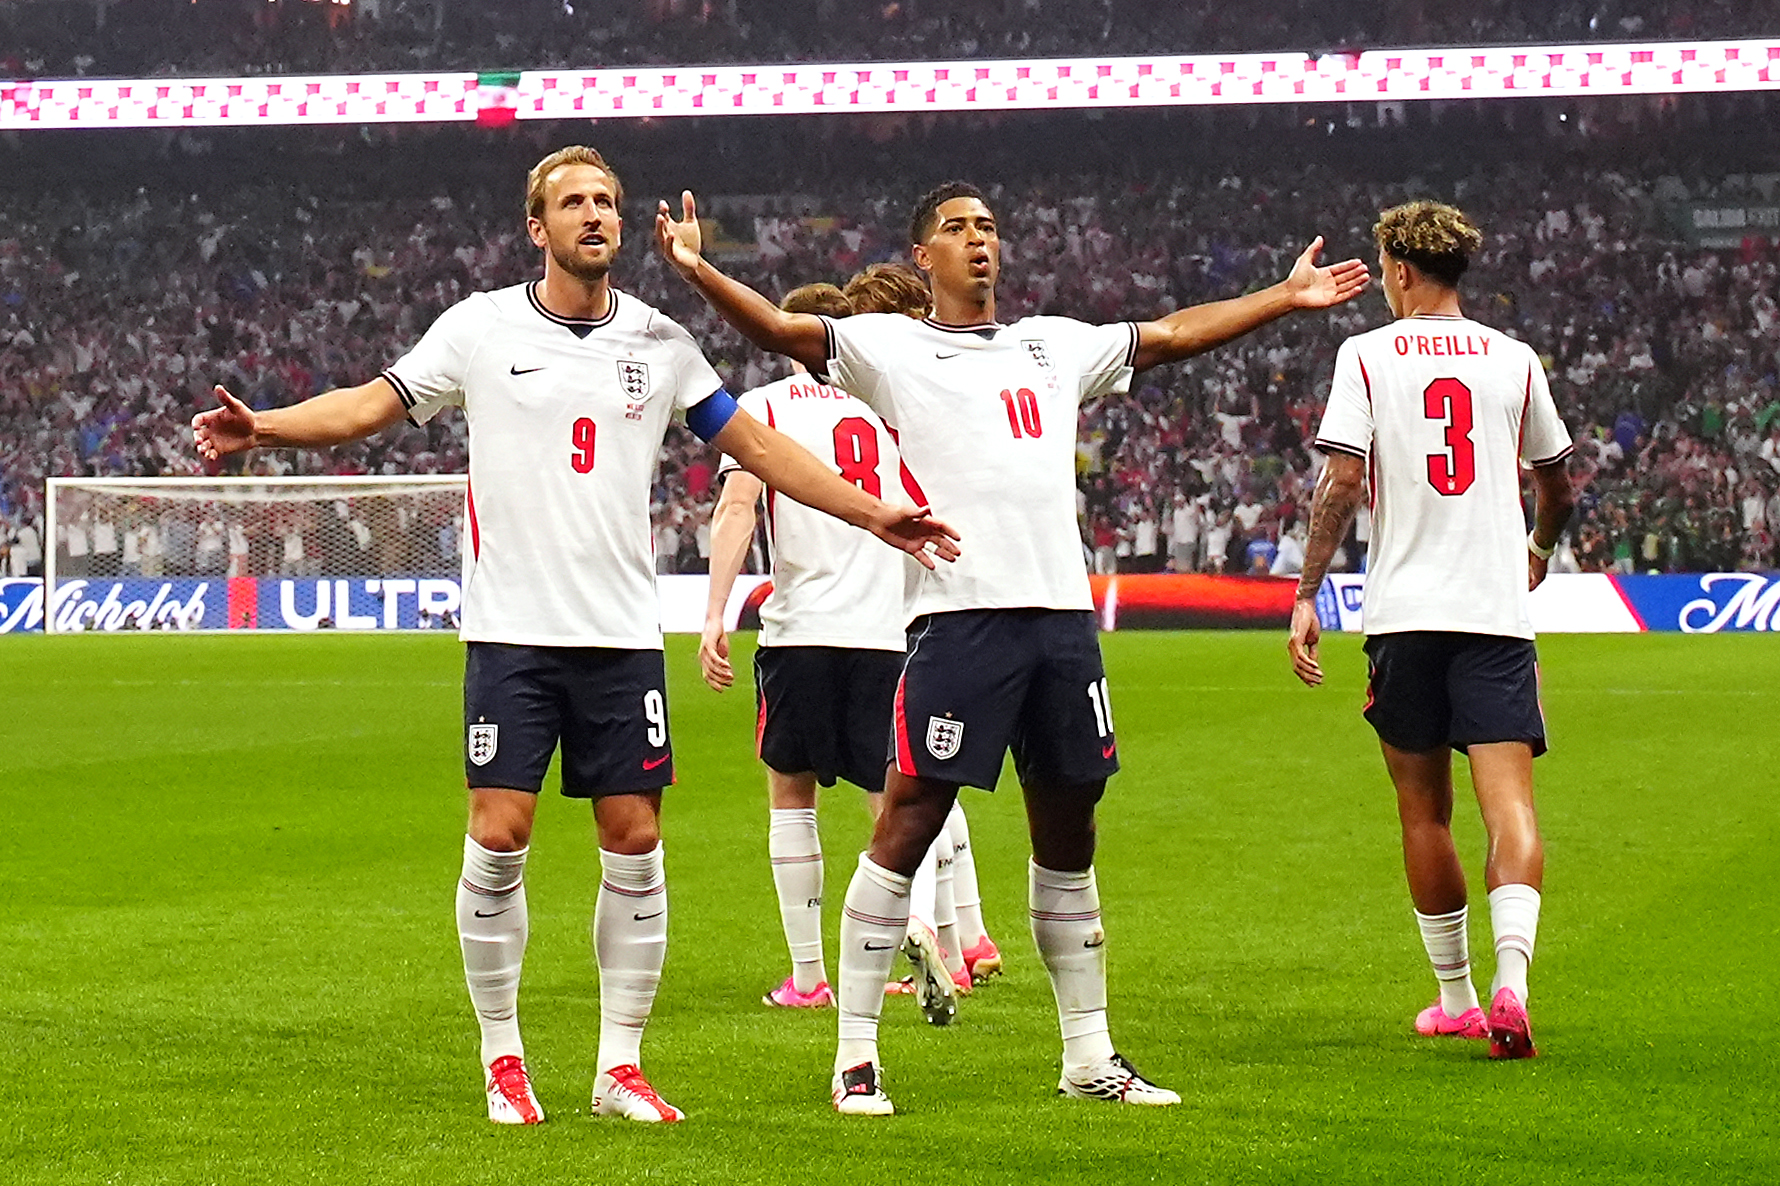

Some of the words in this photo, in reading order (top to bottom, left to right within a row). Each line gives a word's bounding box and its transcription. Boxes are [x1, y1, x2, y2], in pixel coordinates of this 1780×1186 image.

[790, 384, 851, 400] ANDE
[1000, 388, 1043, 439] 10
[571, 417, 596, 474] 9
[832, 416, 882, 500] 8
[1423, 377, 1475, 496] 3
[0, 577, 209, 632] Michelob
[643, 689, 667, 748] 9
